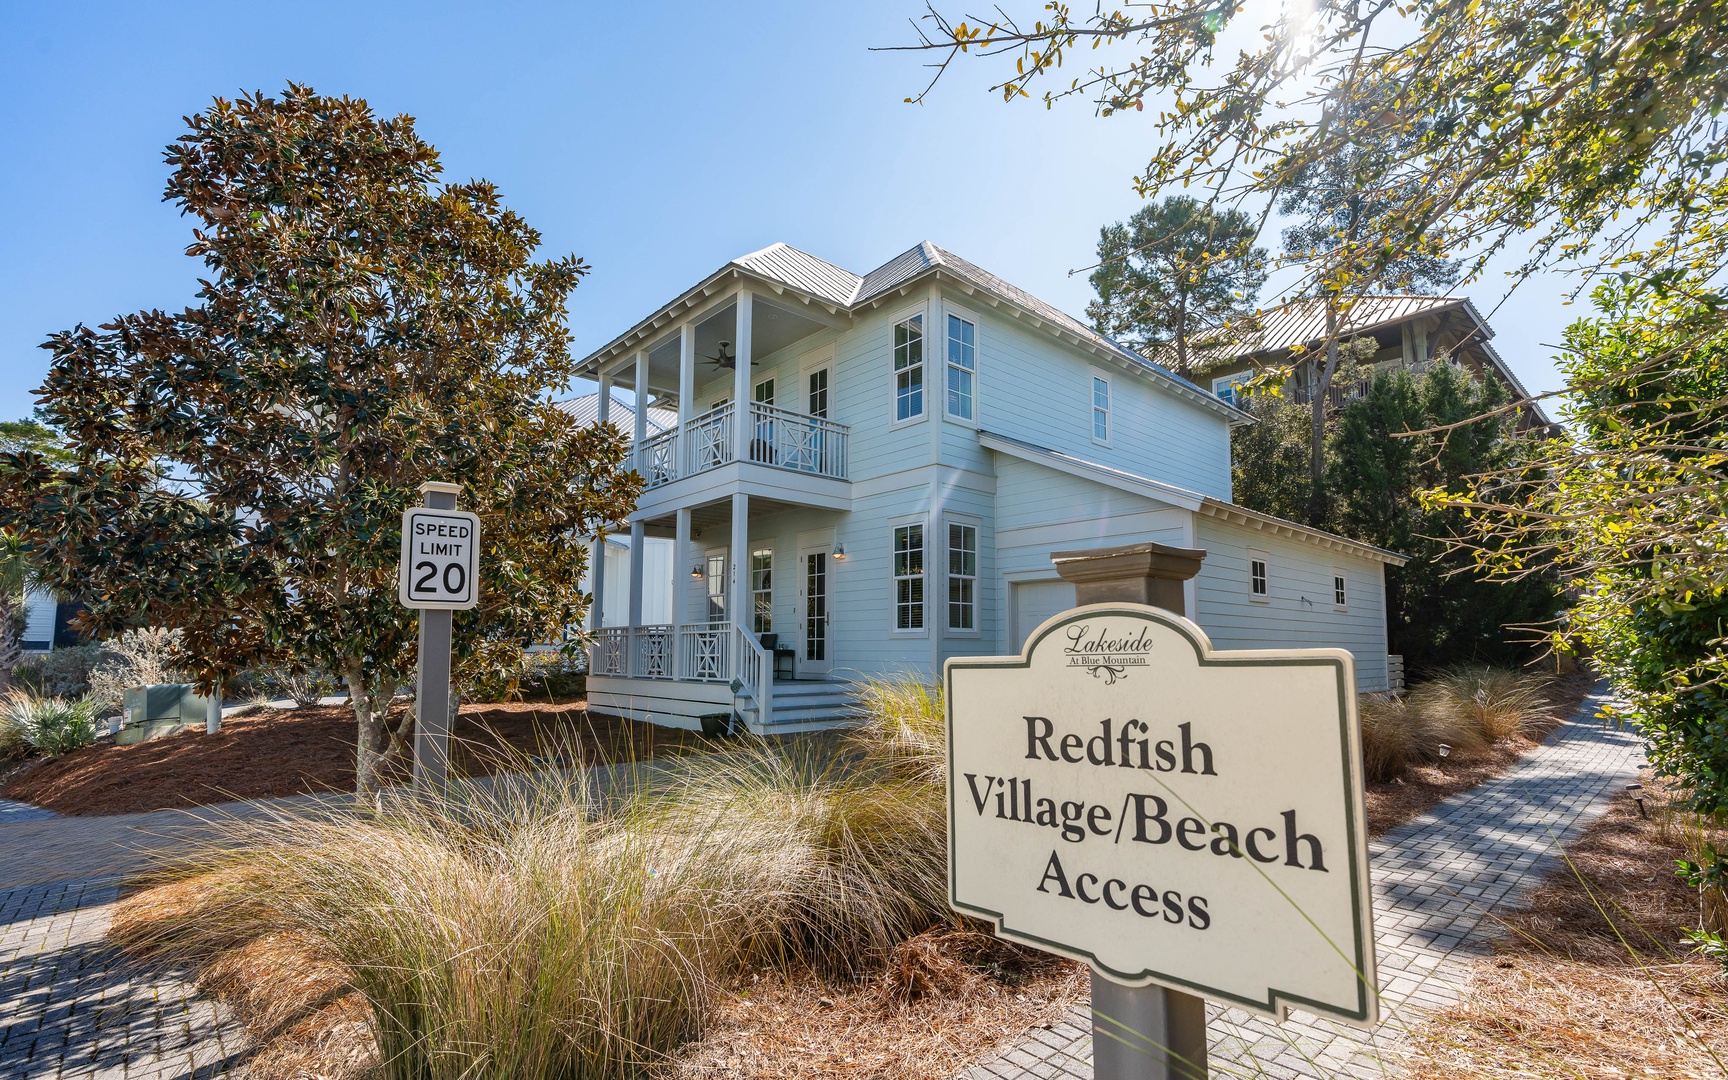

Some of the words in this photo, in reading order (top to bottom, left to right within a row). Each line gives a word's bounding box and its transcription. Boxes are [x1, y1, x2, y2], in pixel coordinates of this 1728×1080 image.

[415, 523, 469, 538] SPEED
[420, 542, 462, 556] LIMIT
[414, 561, 466, 594] 20
[1064, 625, 1153, 653] Lakeside
[1069, 656, 1079, 665] At
[1081, 656, 1100, 665] Blue
[1102, 655, 1146, 665] Mountain
[1023, 716, 1218, 776] Redfish
[964, 773, 1329, 873] Village/Beach
[1036, 849, 1211, 930] Access
